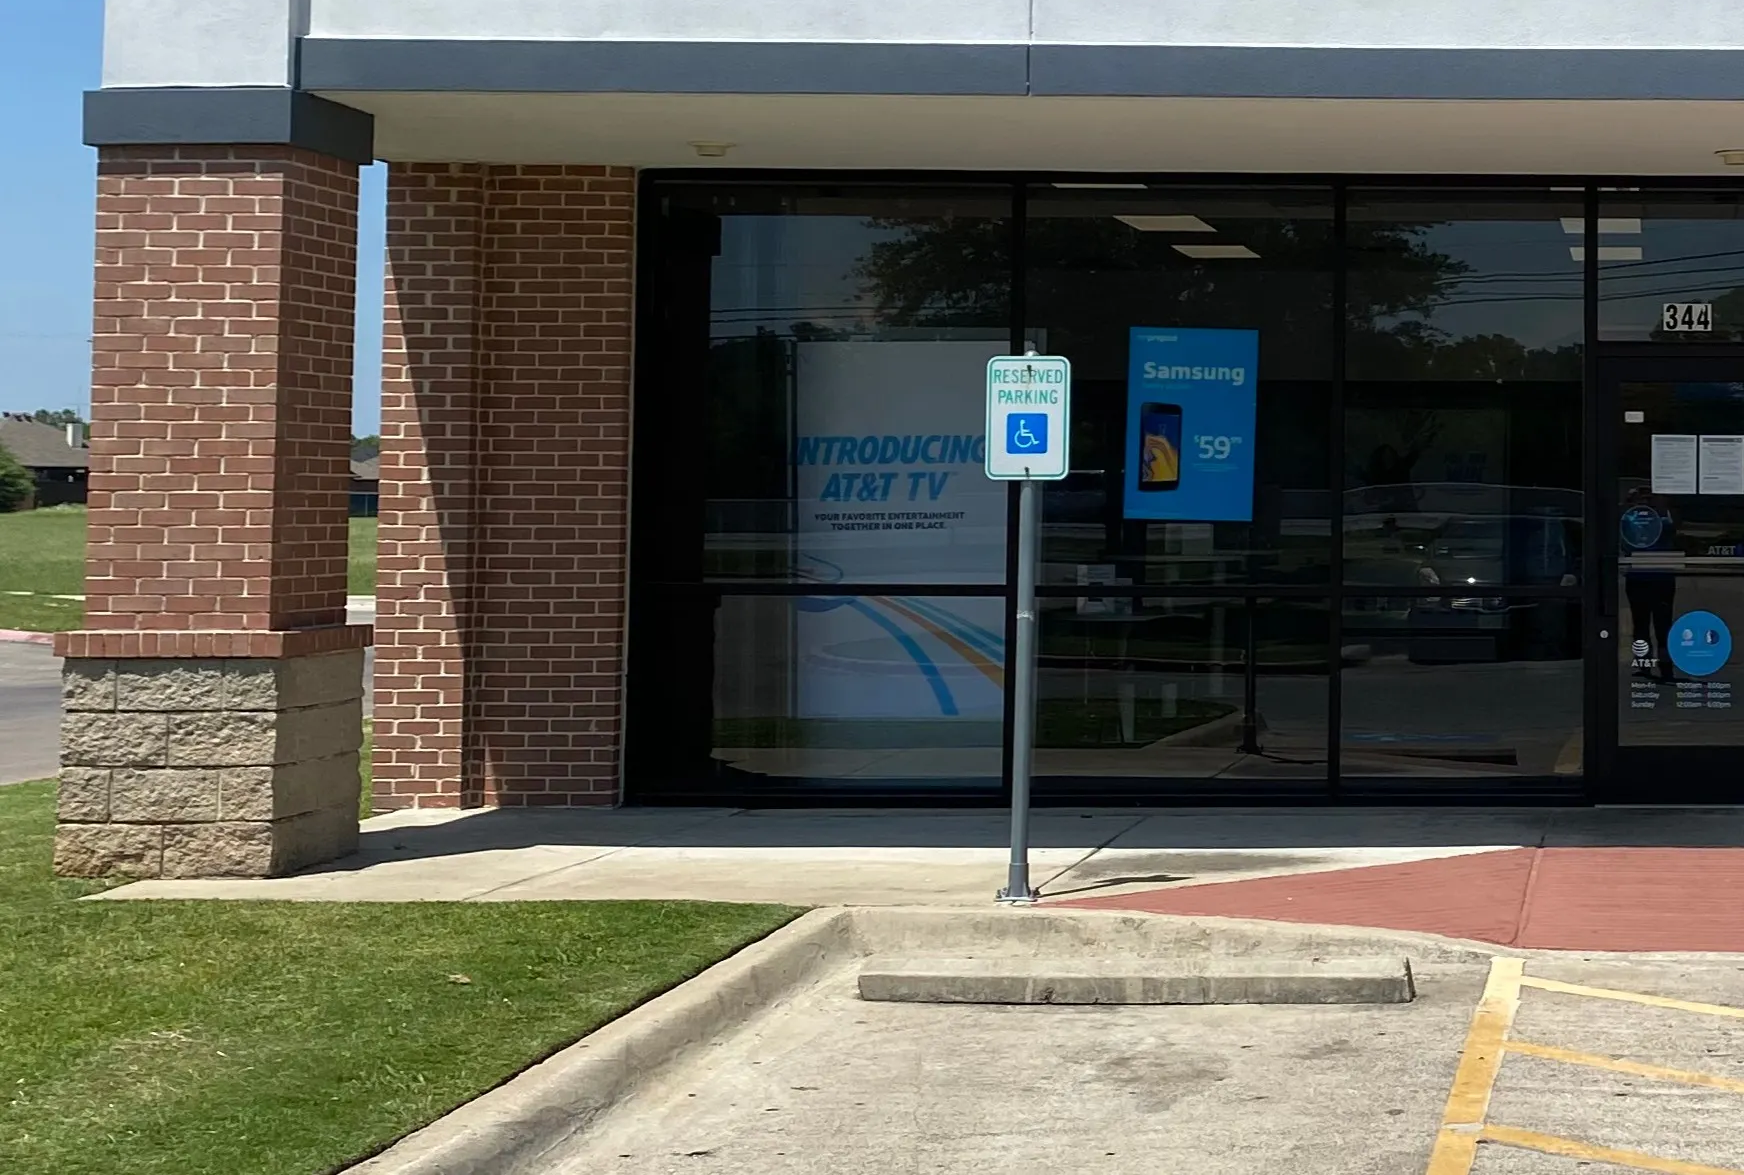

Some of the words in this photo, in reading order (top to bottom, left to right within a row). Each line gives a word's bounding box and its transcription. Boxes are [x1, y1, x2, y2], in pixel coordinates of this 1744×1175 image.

[1665, 304, 1709, 330] 344
[993, 369, 1063, 384] RESERVED
[1143, 361, 1245, 386] Samsung
[998, 389, 1058, 405] PARKING
[796, 435, 985, 466] NTRODUCING
[819, 472, 899, 502] AT&T
[907, 472, 950, 502] TV
[814, 512, 840, 522] YOUR
[841, 512, 886, 521] FAVORITE
[887, 511, 965, 521] ENTERTAINMENT
[831, 522, 880, 531] TOGETHER
[894, 522, 914, 531] ONE
[1707, 545, 1736, 556] AT&T
[1631, 658, 1658, 668] AT&T
